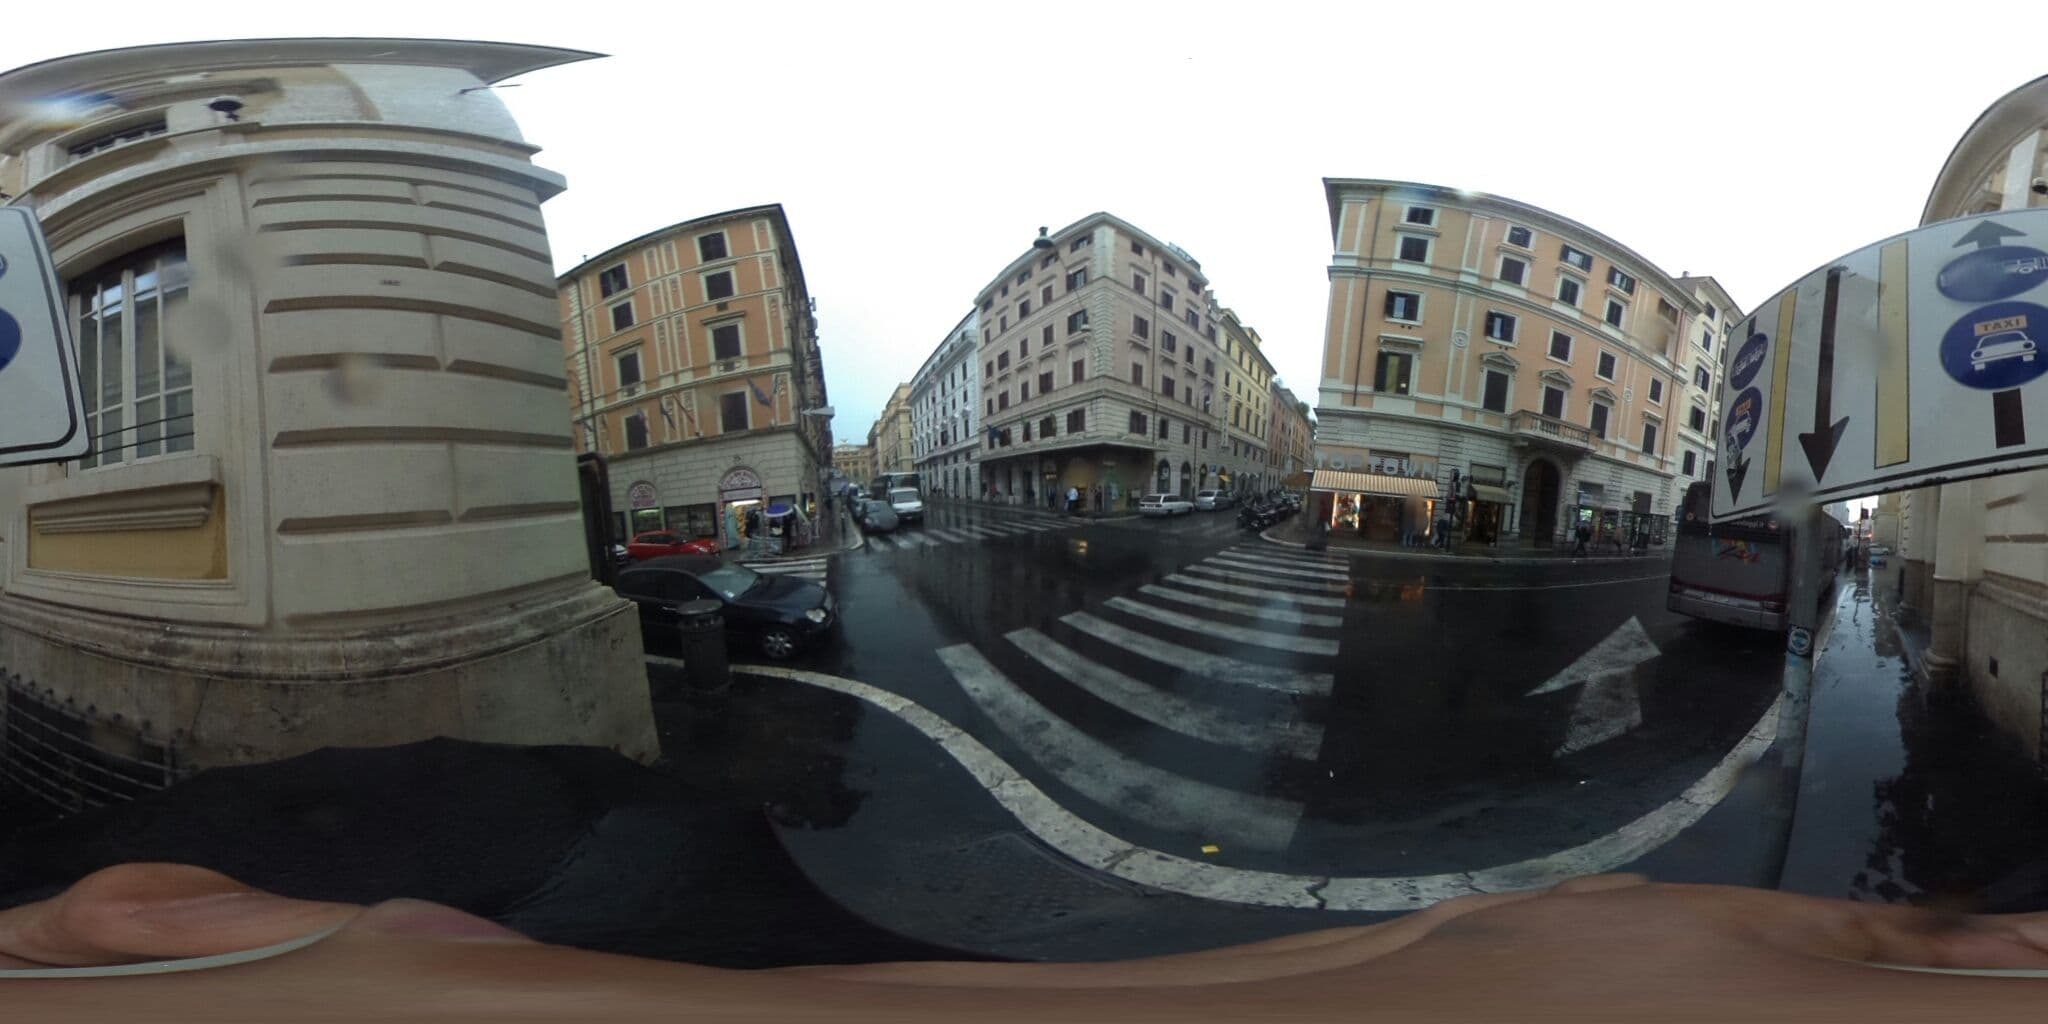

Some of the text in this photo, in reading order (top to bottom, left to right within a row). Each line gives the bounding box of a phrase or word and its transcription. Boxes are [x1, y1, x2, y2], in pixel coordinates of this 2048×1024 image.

[1982, 318, 2020, 331] TAXI
[1315, 448, 1434, 479] TOP TOWN
